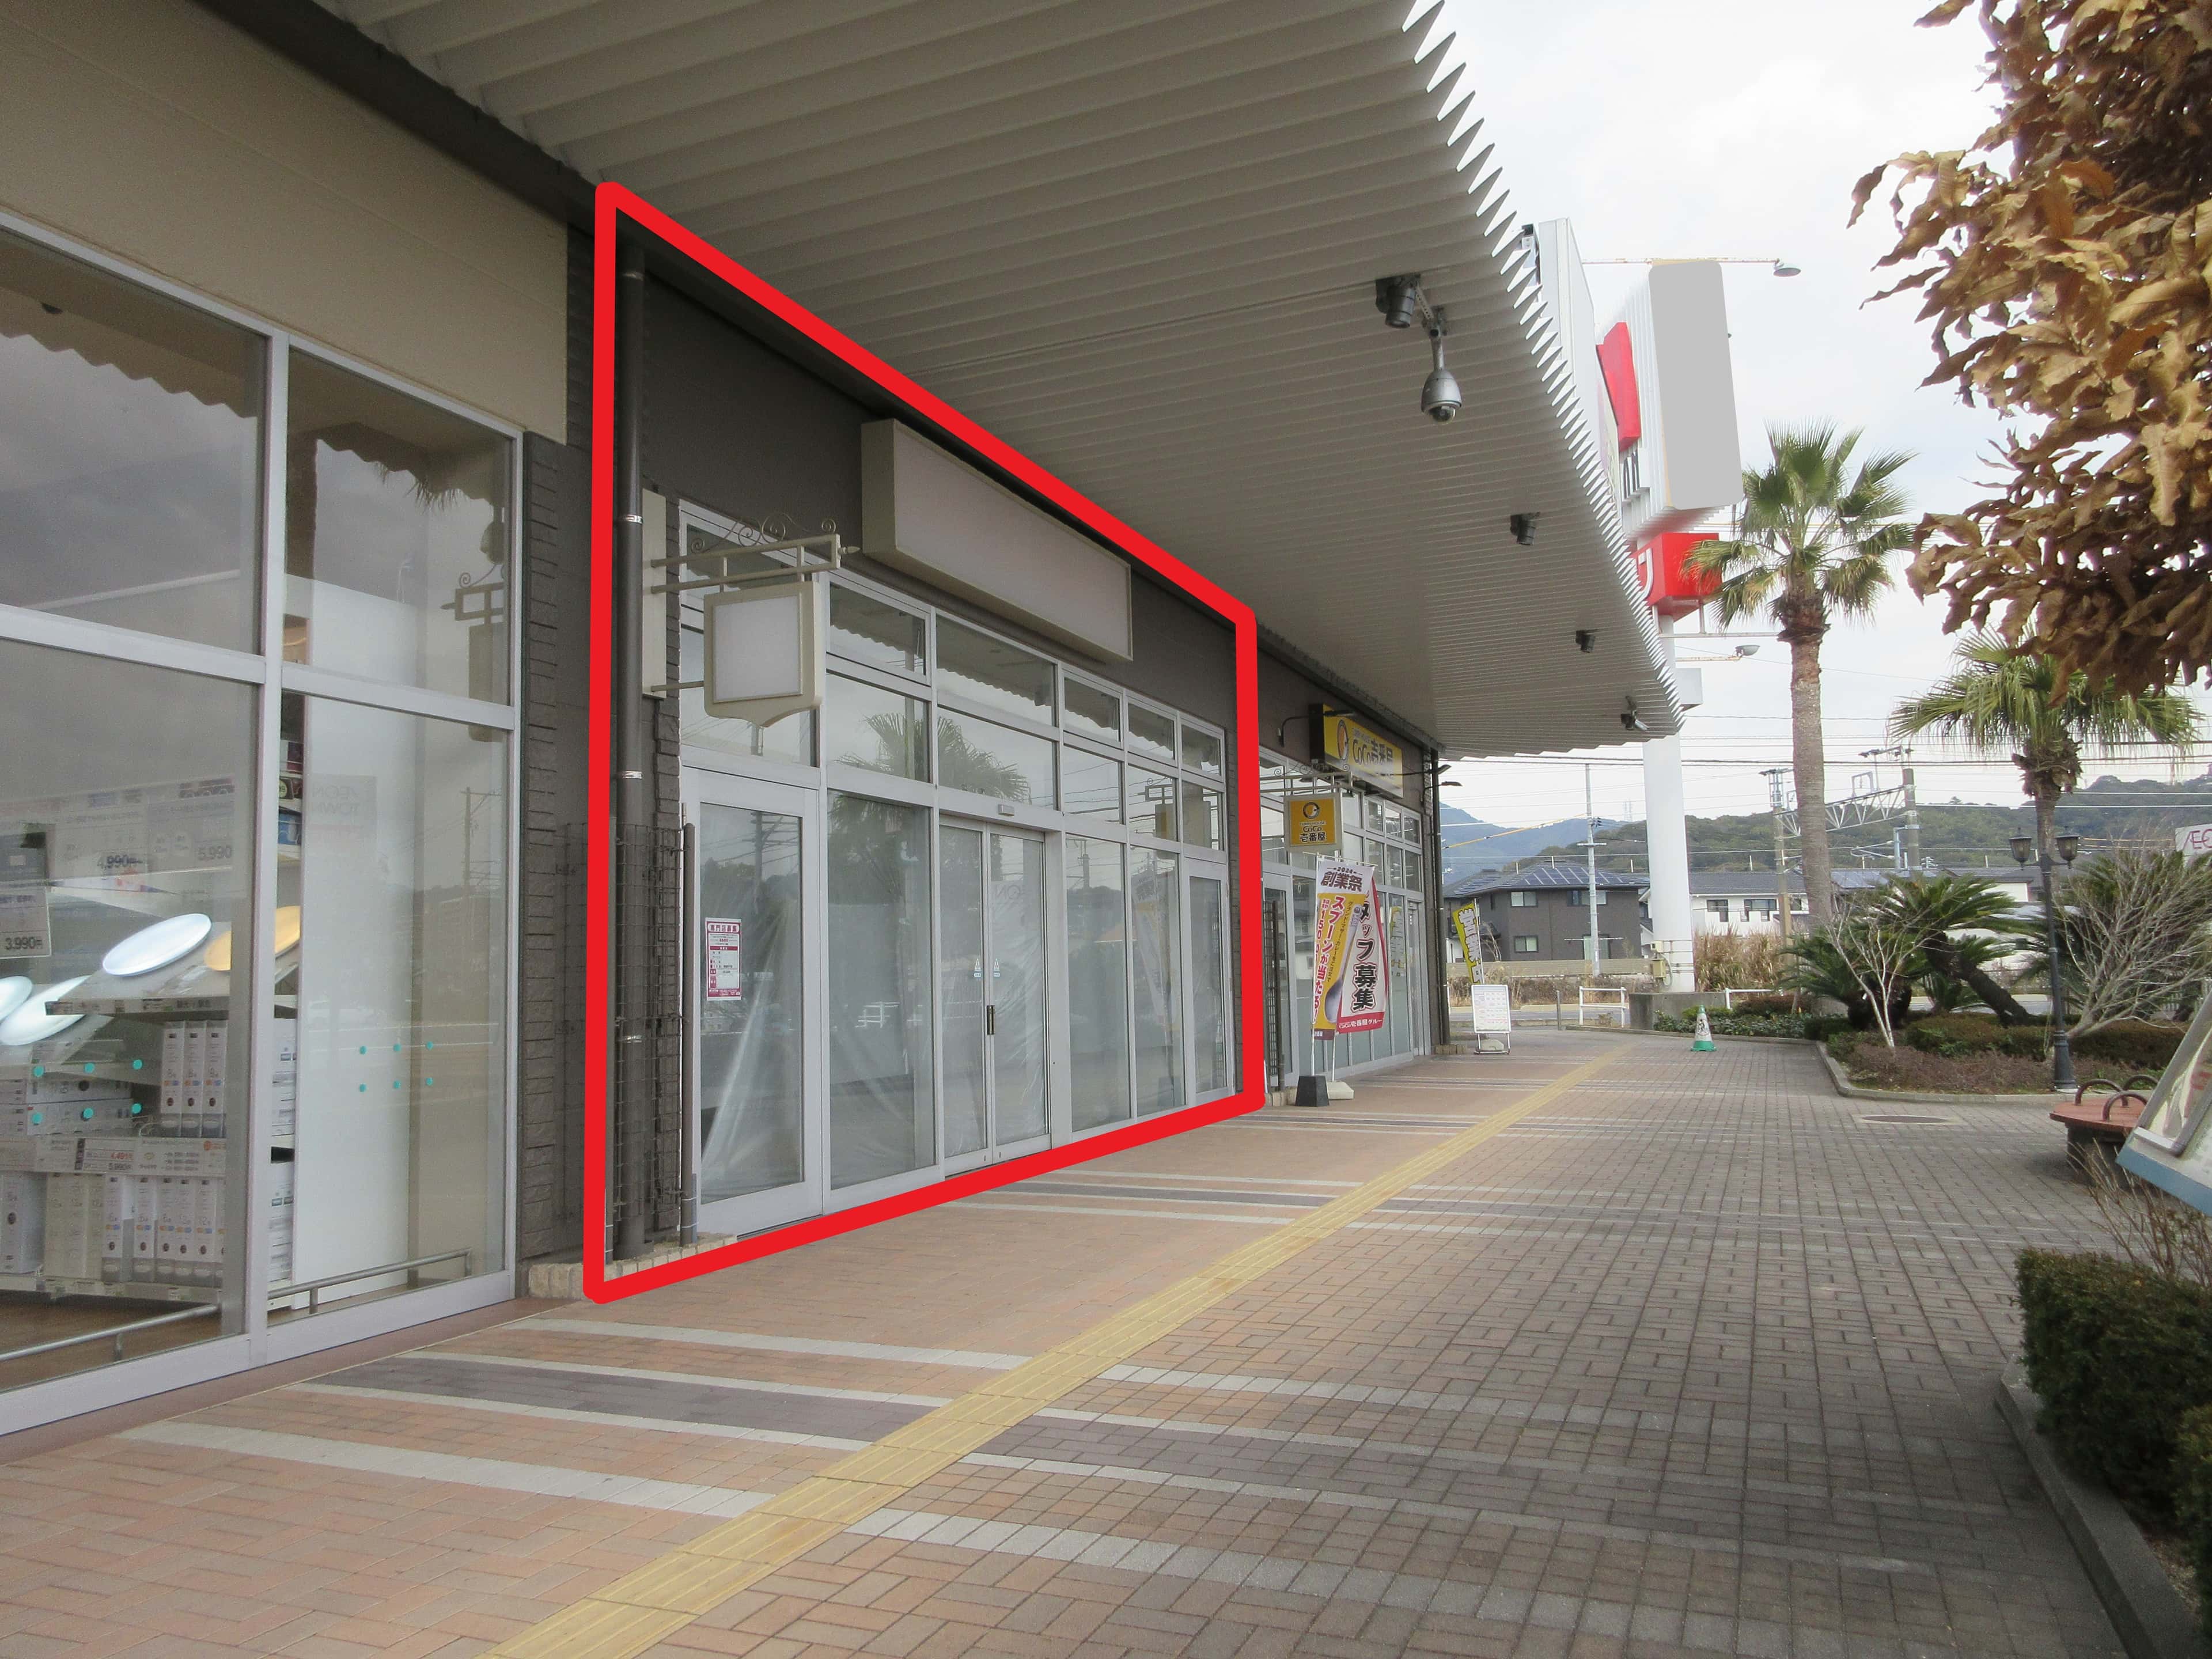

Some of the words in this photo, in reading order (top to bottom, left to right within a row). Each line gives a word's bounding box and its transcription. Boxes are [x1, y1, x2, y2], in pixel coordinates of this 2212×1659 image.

[1300, 832, 1325, 842] 壱番屋
[1320, 871, 1362, 892] 創業祭
[1352, 891, 1377, 1012] タッフ募集
